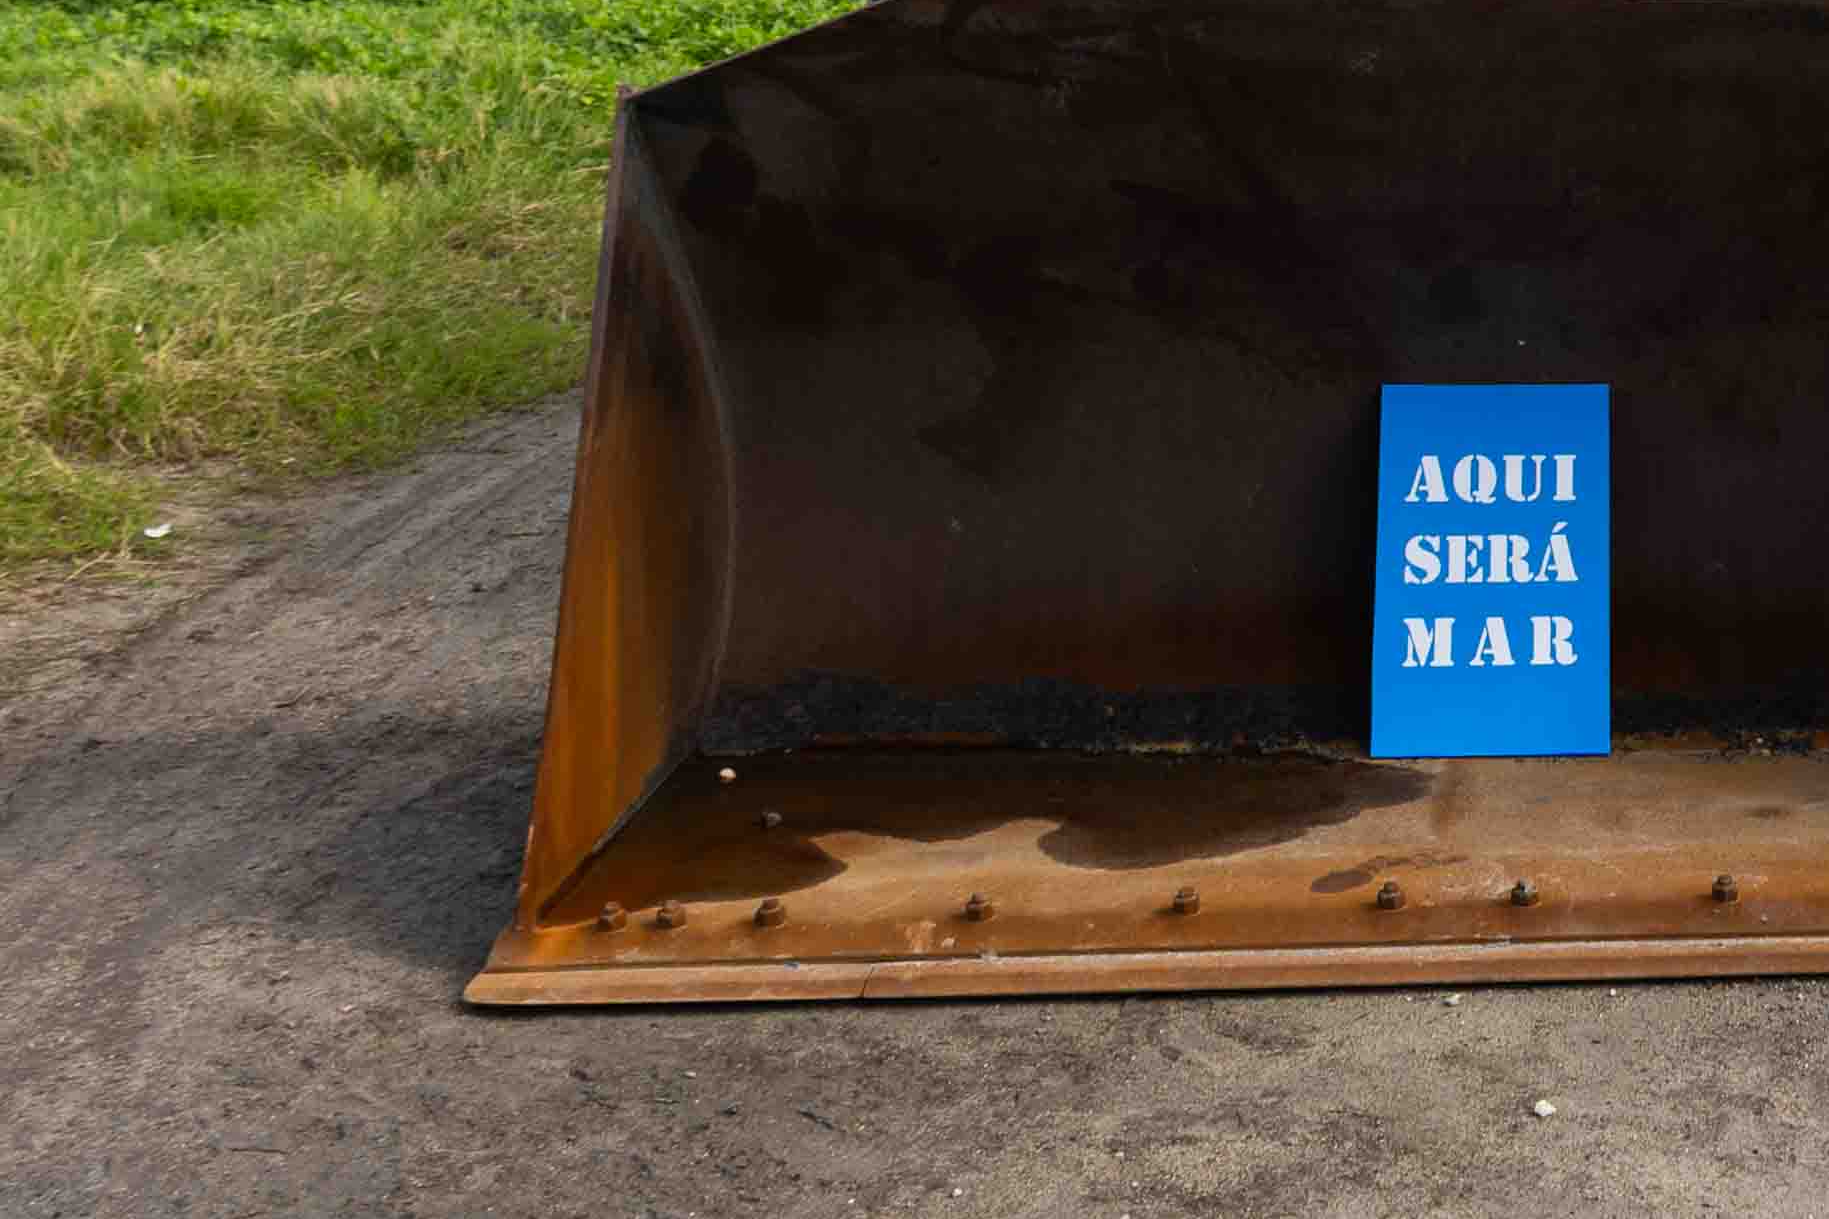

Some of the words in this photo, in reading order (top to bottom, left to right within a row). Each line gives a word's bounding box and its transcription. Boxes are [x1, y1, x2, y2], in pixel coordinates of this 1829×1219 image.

[1404, 454, 1577, 505] AQUI
[1403, 521, 1579, 585] SERÁ
[1401, 615, 1578, 668] MAR
